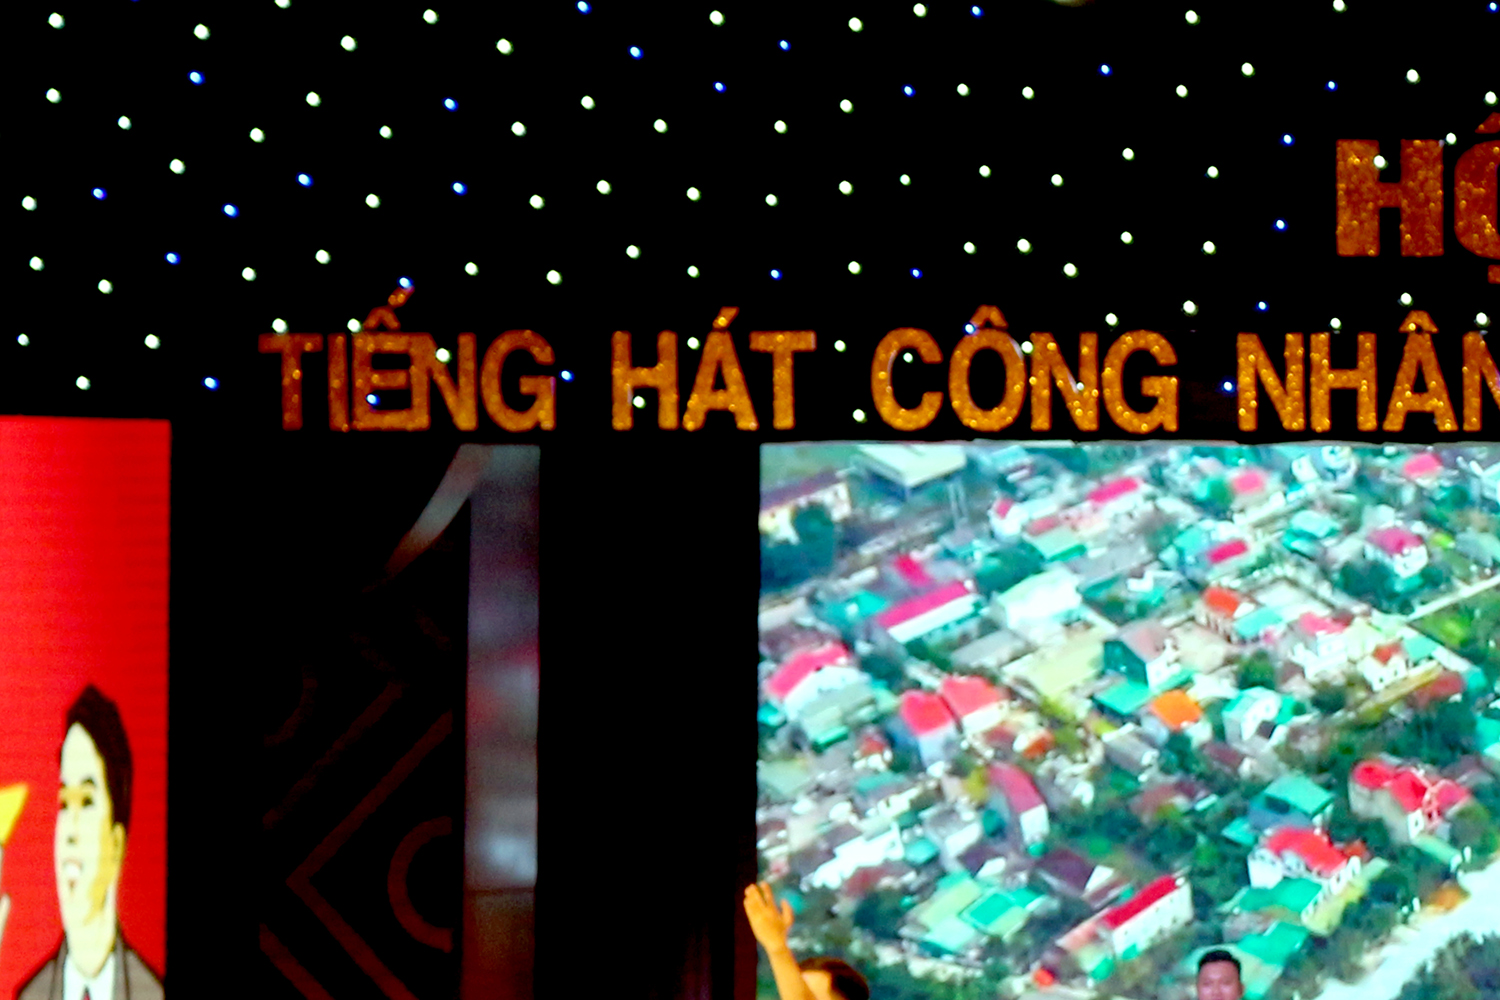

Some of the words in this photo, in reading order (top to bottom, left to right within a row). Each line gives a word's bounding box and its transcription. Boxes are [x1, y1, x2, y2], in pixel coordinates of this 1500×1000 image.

[258, 286, 556, 432] TIẾNG
[611, 307, 817, 432] HÁT
[871, 305, 1179, 434] CÔNG
